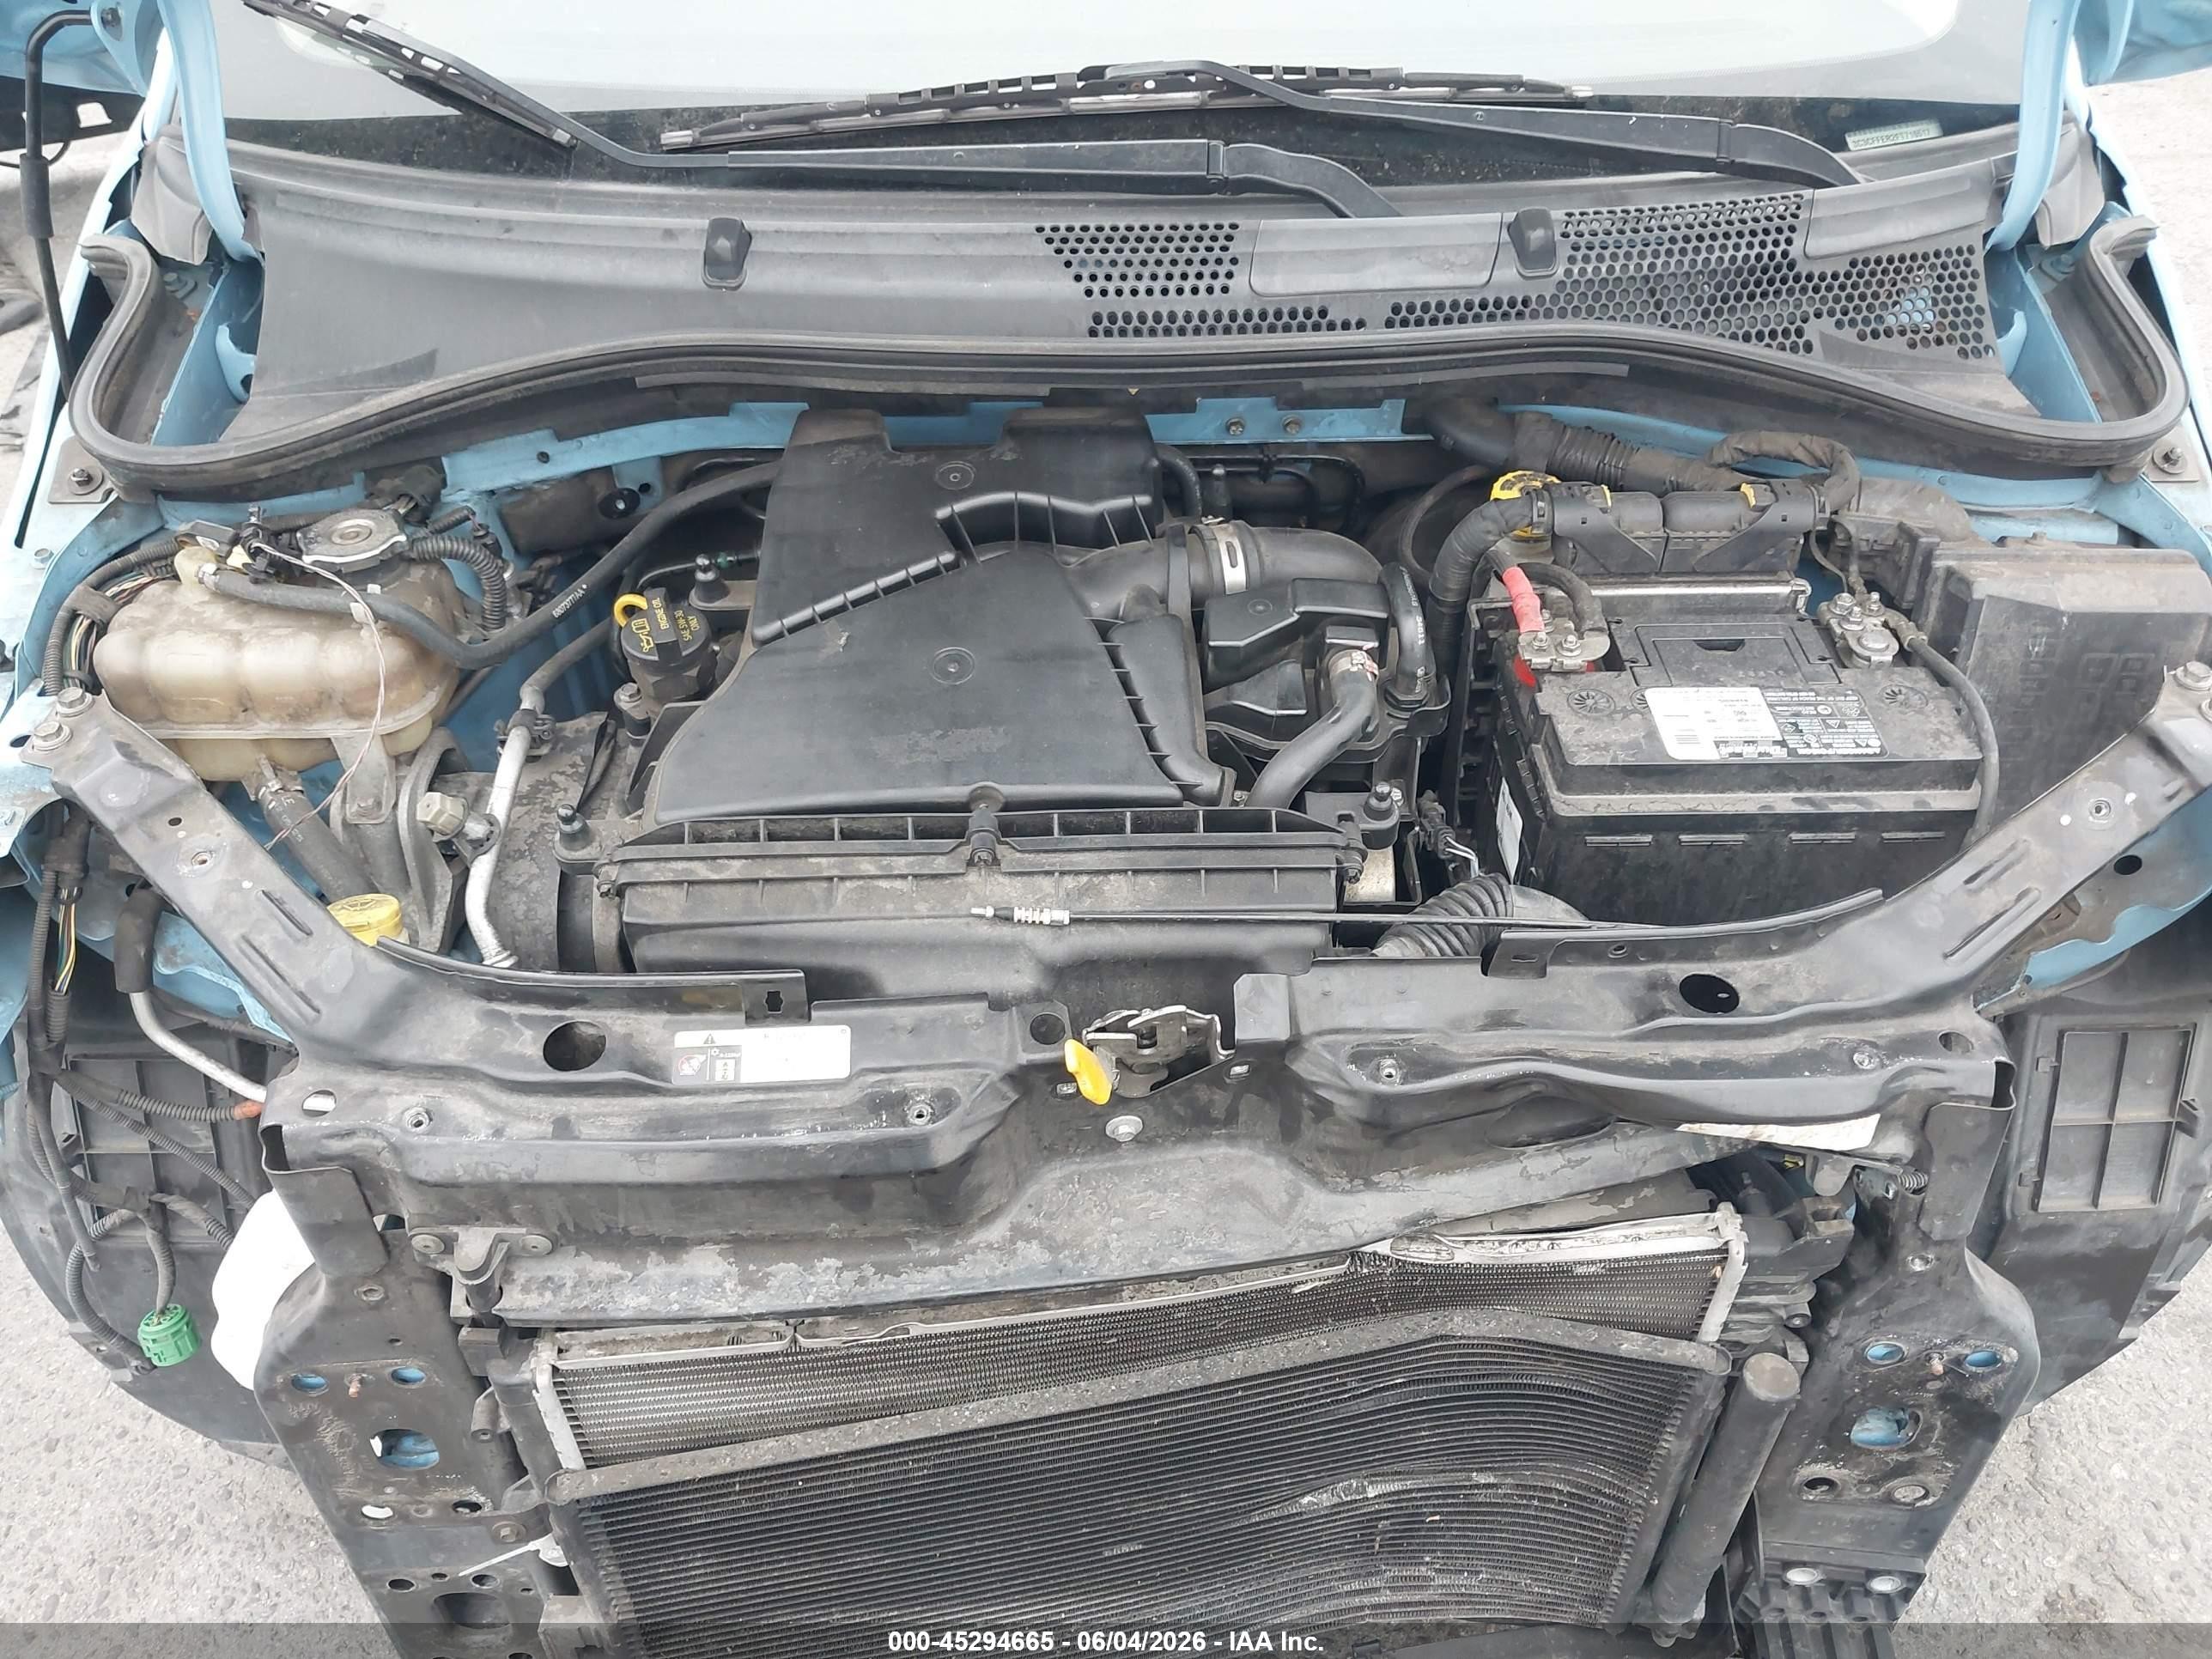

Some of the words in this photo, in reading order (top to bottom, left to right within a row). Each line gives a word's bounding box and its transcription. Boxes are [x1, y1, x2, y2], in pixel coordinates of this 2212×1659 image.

[652, 597, 663, 608] OIL
[655, 608, 670, 630] ENGINE
[673, 610, 689, 629] 5W-30
[687, 615, 701, 631] ONLY
[679, 629, 693, 641] SAE
